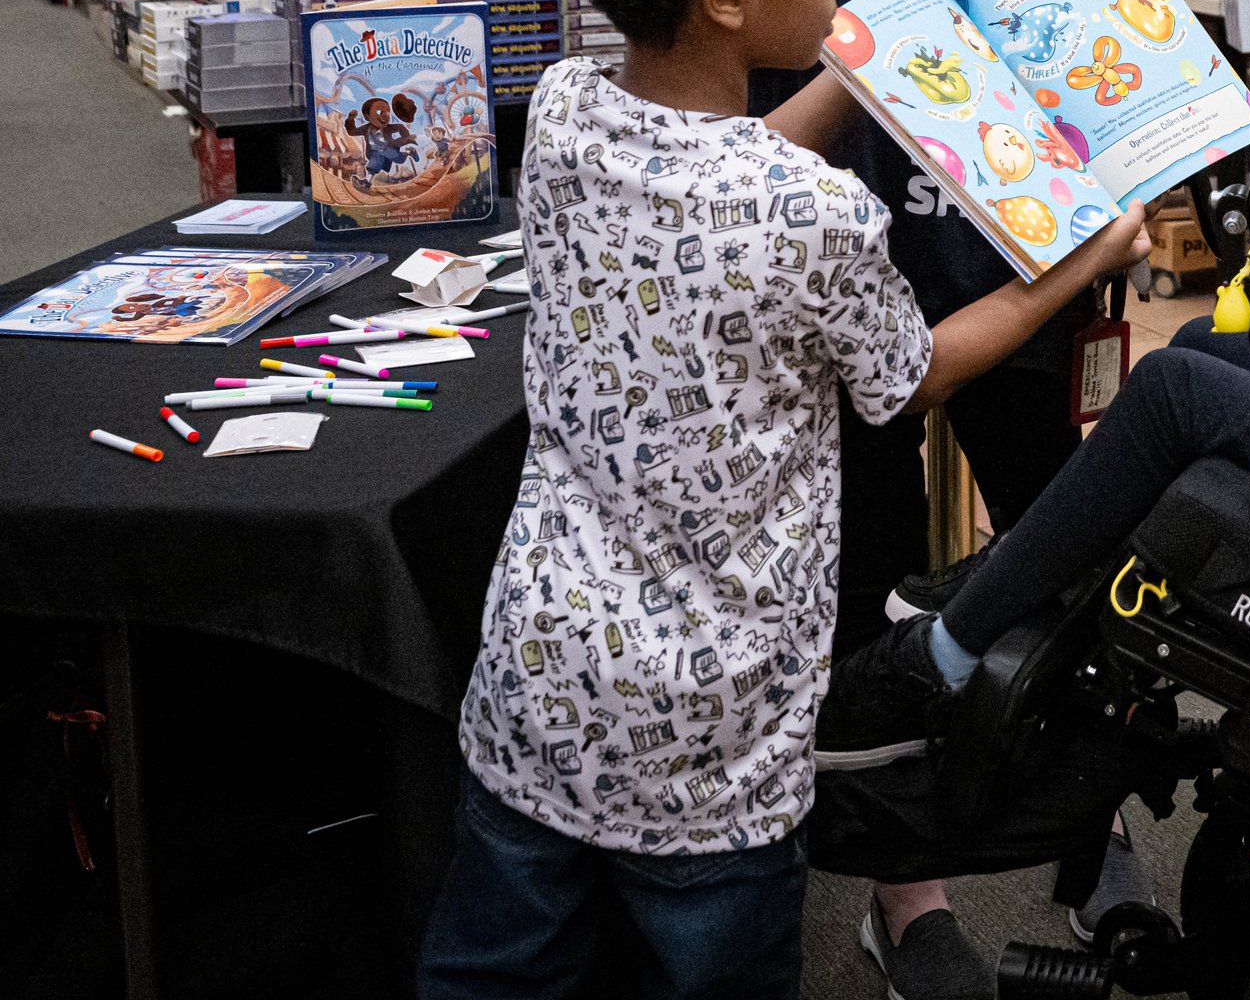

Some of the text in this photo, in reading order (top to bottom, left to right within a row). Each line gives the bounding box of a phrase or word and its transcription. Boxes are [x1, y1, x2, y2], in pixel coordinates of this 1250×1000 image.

[327, 30, 472, 73] The Data Detective
